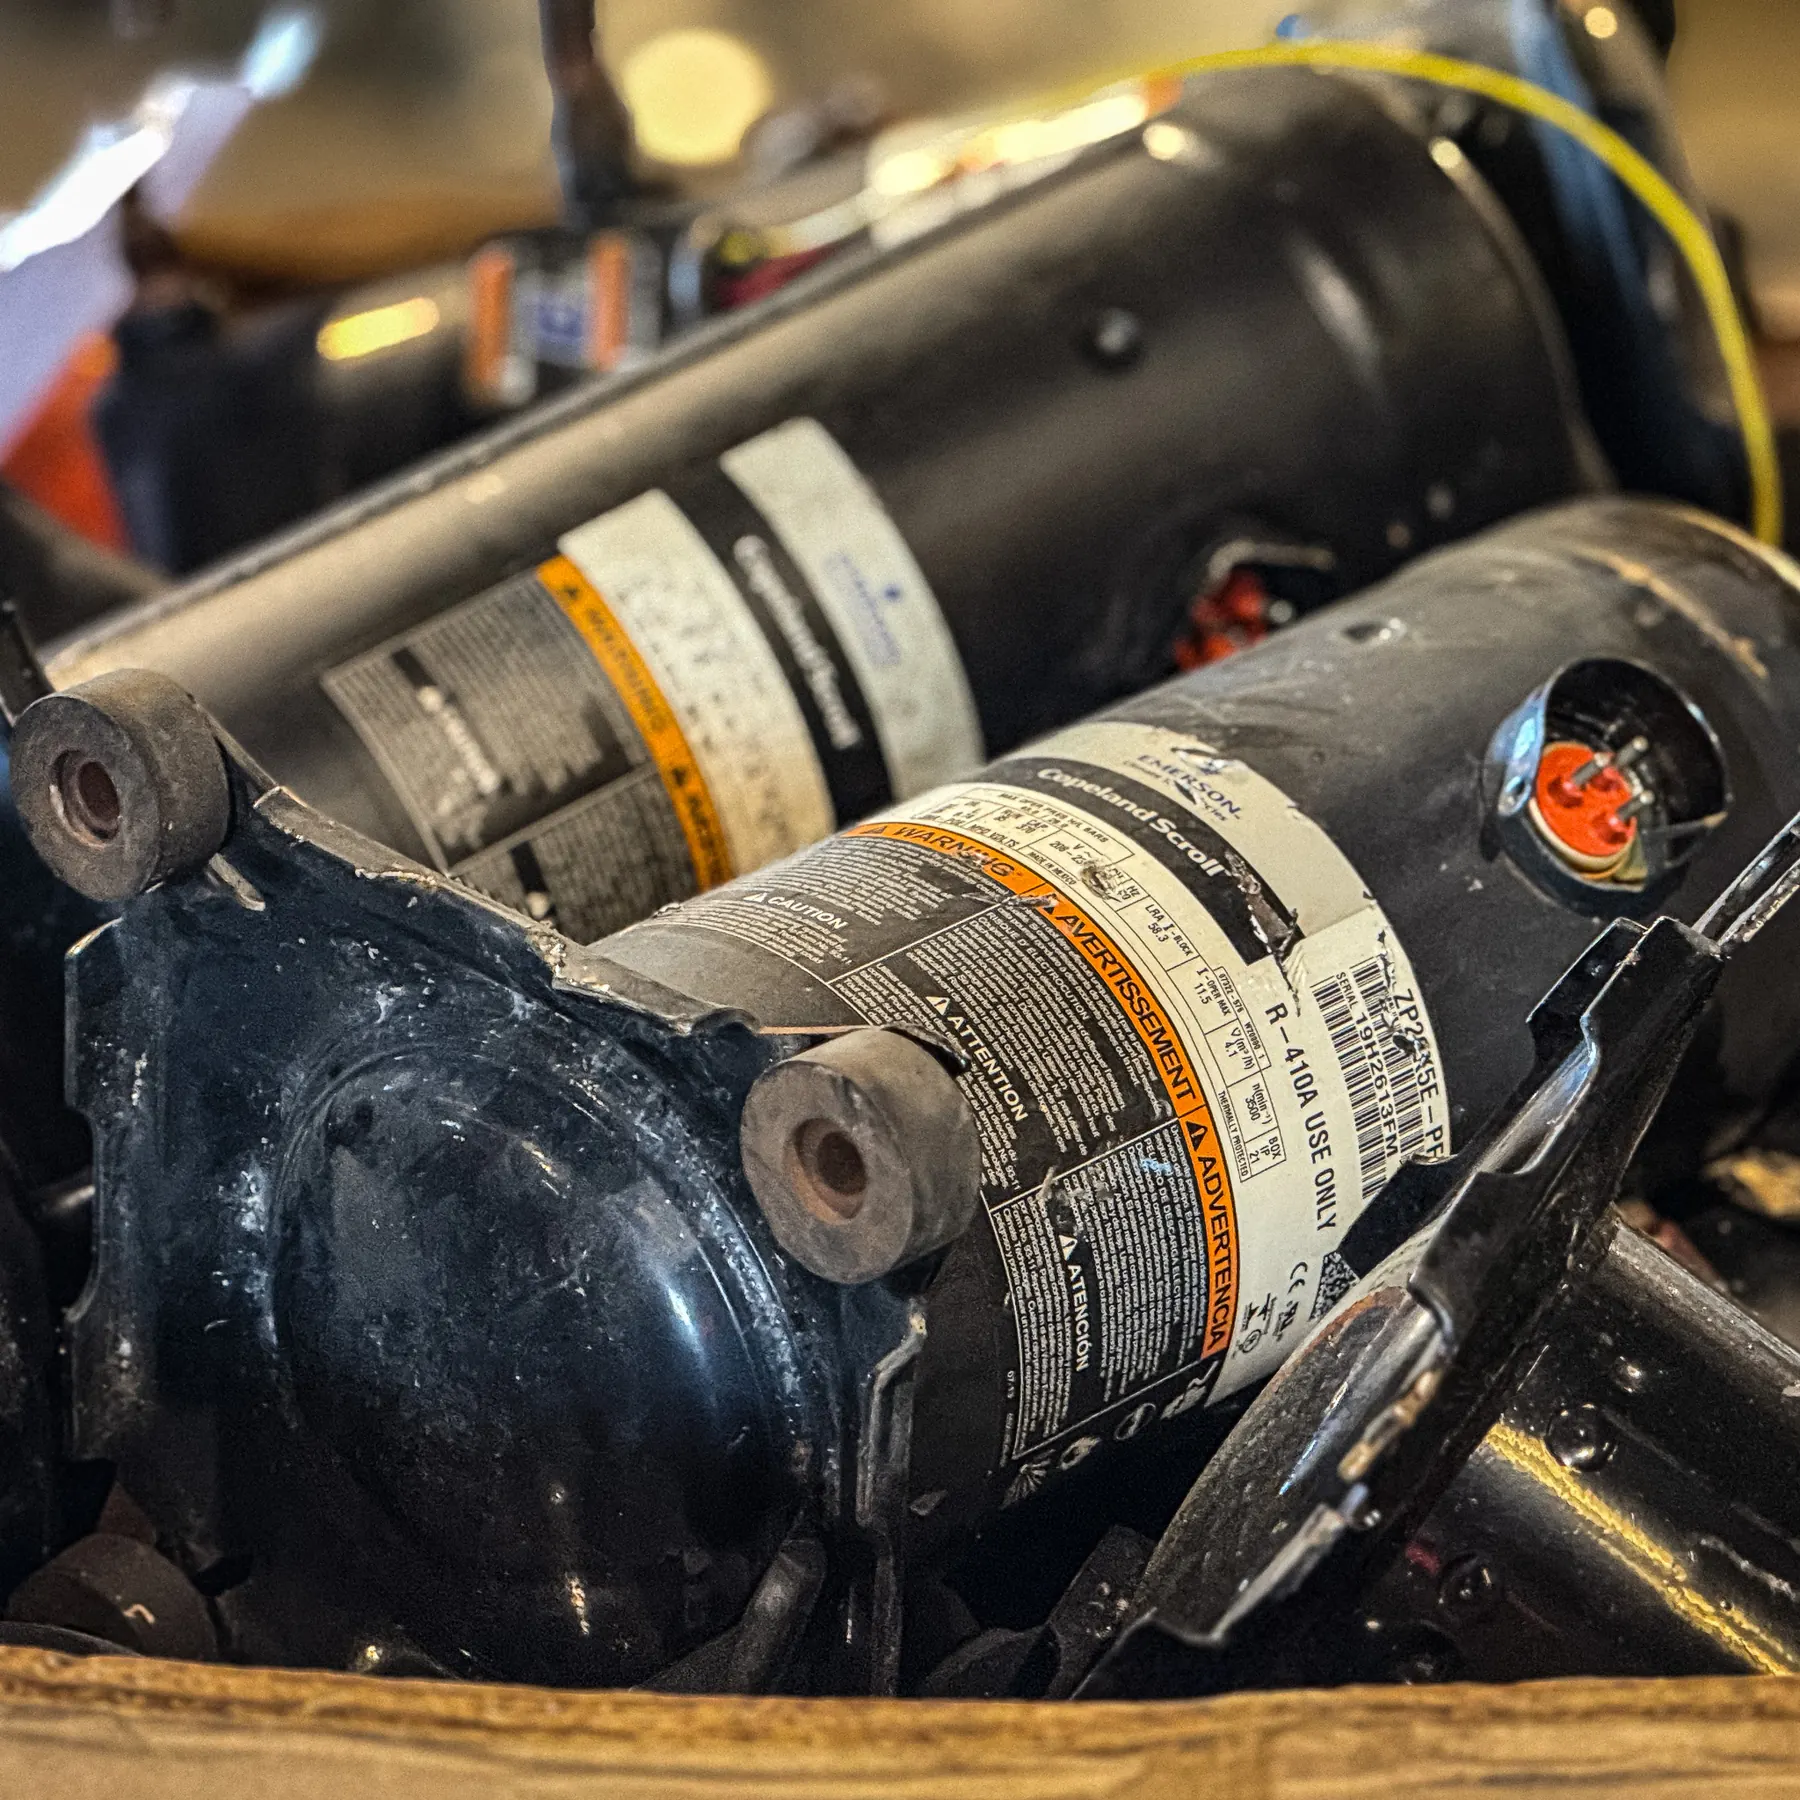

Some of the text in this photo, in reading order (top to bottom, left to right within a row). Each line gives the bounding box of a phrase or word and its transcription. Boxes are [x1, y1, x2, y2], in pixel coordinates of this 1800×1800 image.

[1138, 755, 1240, 813] EMERSON
[1038, 768, 1156, 820] Copeland
[1150, 818, 1223, 875] Scroll
[1083, 827, 1108, 842] BARS
[987, 831, 1019, 847] VOLTS
[1027, 851, 1046, 864] MADE
[1052, 867, 1076, 884] MEXICO
[768, 896, 846, 928] CAUTION
[1144, 903, 1164, 921] LRA
[1147, 922, 1169, 942] 58.3
[986, 911, 1019, 939] RISQUE
[1026, 947, 1088, 1019] ÉLECTROCUTION
[1058, 916, 1194, 1098] AVERTISSEMENT
[1194, 982, 1212, 1004] 11.5
[1217, 999, 1231, 1016] MAX
[1224, 1041, 1238, 1057] 4.1
[1336, 971, 1357, 1008] SERIAL
[1356, 1014, 1397, 1156] 19H2613FM
[948, 1016, 1027, 1120] ATTENTION
[1245, 1094, 1260, 1120] 3500
[1266, 1003, 1336, 1230] R-410A USE ONLY
[1218, 1090, 1248, 1176] THERMALLY PROTECTED
[1259, 1144, 1270, 1155] IP
[1268, 1136, 1281, 1159] BOX
[1248, 1149, 1260, 1164] 21
[1005, 1164, 1020, 1190] 93-11
[1144, 1137, 1163, 1185] PELIGRO
[1158, 1186, 1168, 1202] DE
[1163, 1204, 1177, 1264] DESCARGA
[1002, 1207, 1017, 1240] Climate
[1011, 1203, 1022, 1227] Form
[1023, 1244, 1035, 1269] 93-11
[1199, 1157, 1231, 1348] ADVERTENCIA
[1068, 1265, 1091, 1370] ATENCIÓN
